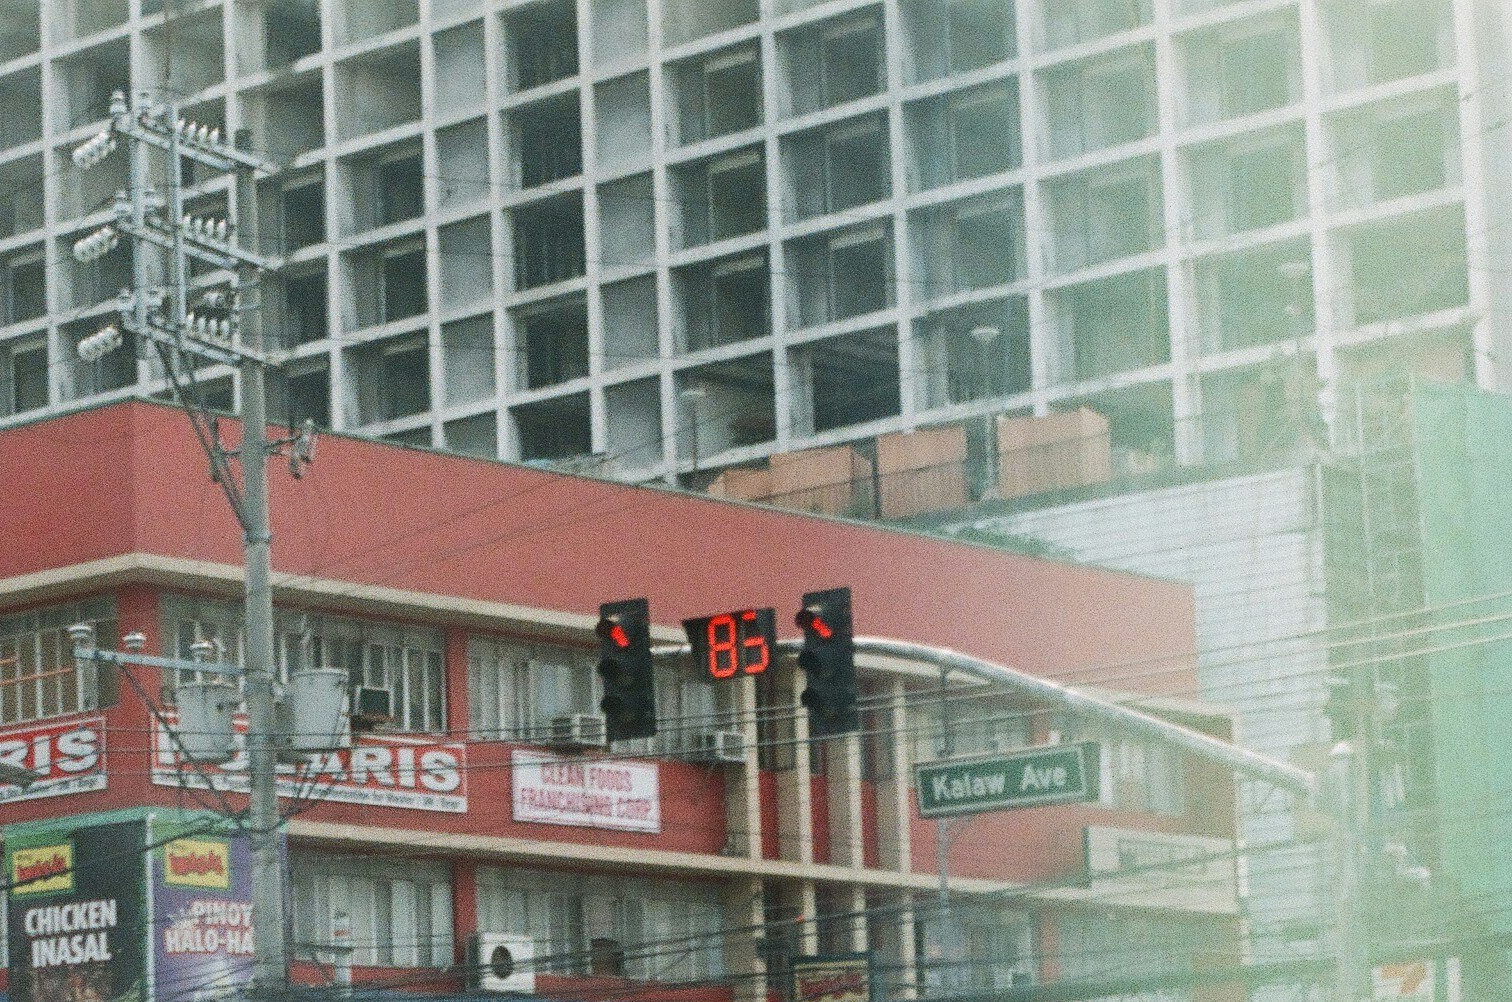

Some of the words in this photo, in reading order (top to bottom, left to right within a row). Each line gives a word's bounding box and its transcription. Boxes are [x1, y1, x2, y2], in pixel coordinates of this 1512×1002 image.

[933, 773, 1005, 800] Kalaw
[1021, 765, 1067, 791] Ave
[24, 899, 117, 936] CHICKEN
[31, 931, 111, 968] INASAL
[165, 928, 255, 955] HALO-HA
